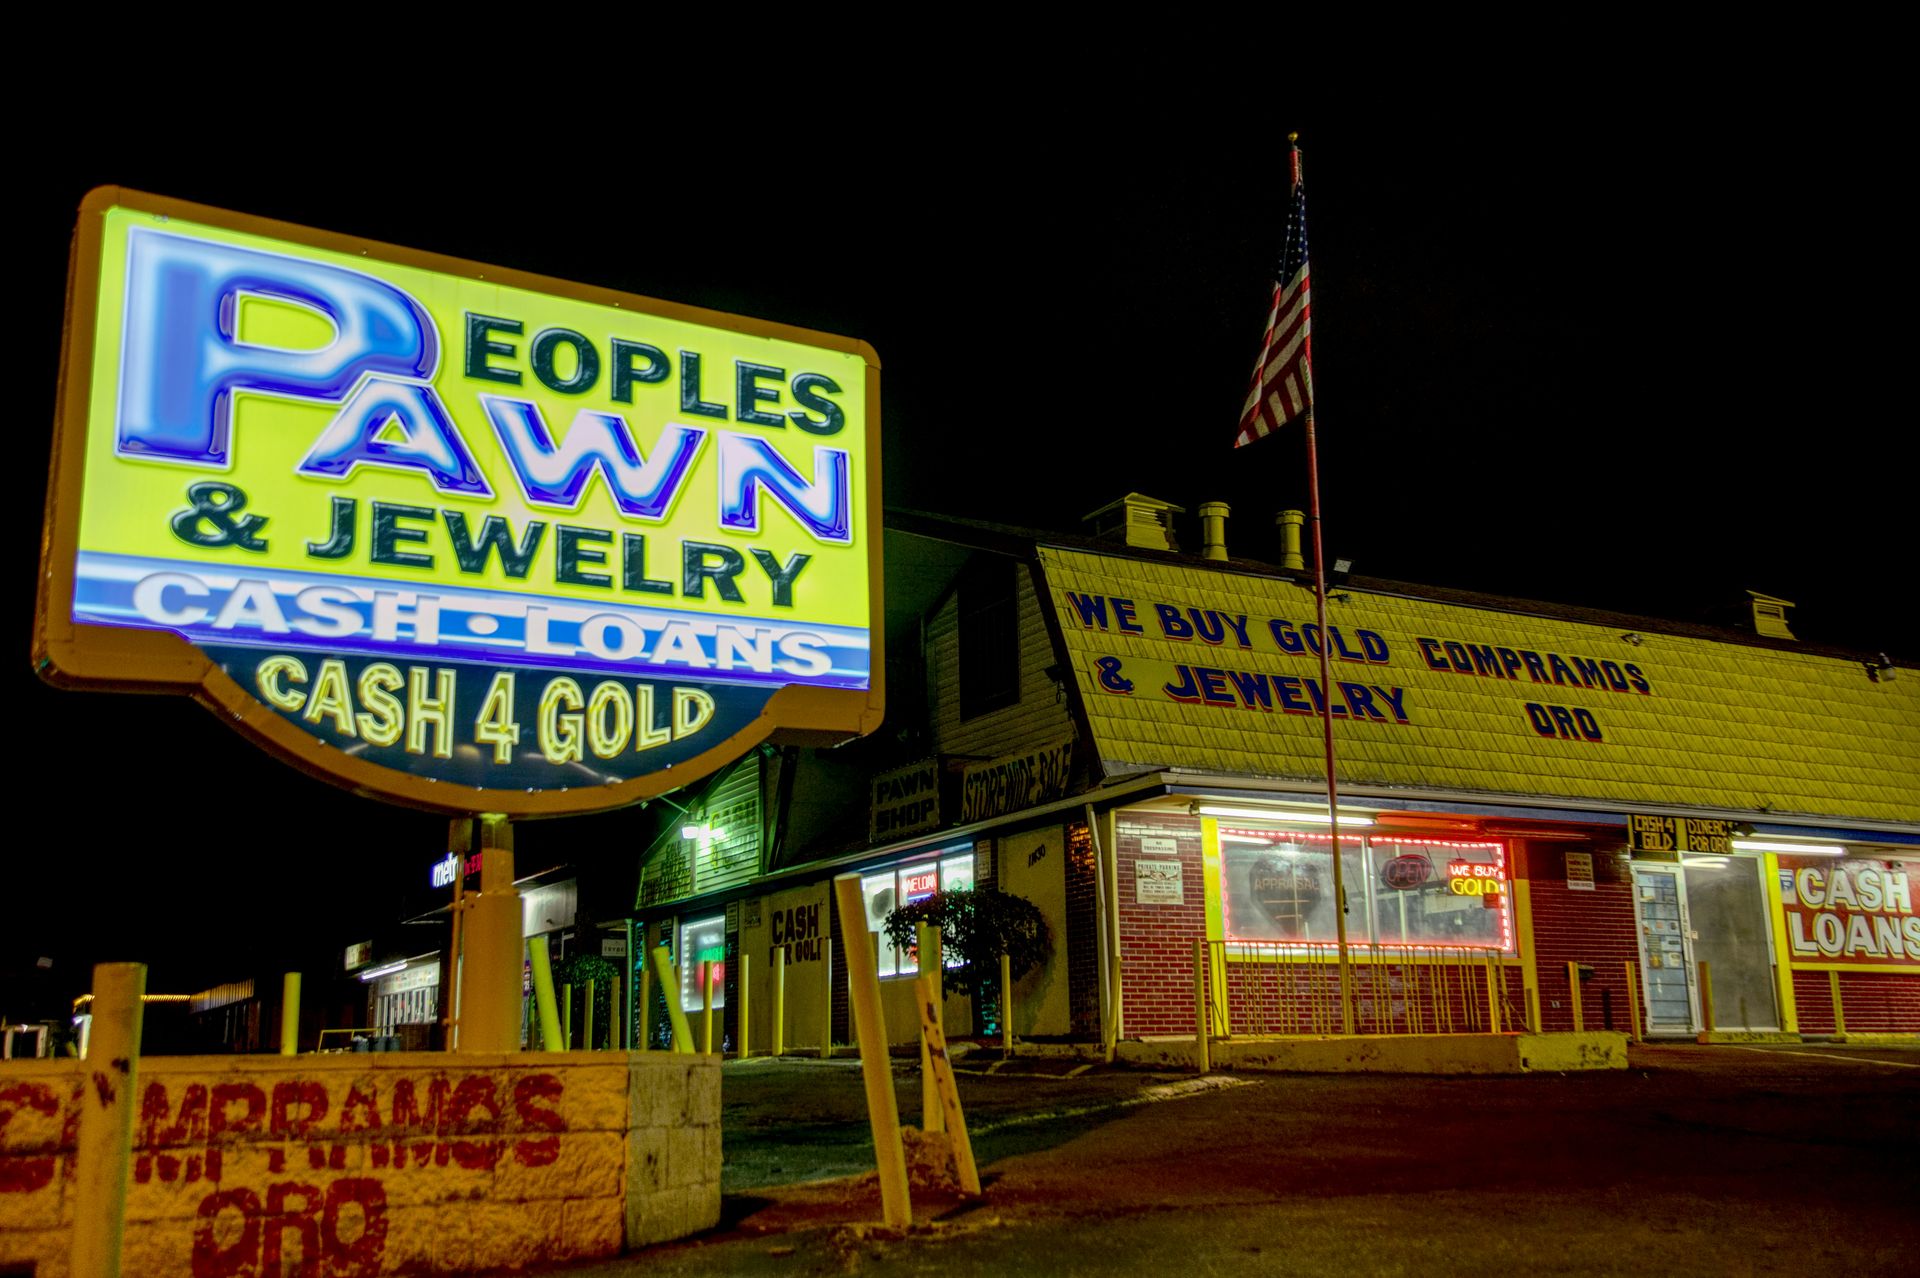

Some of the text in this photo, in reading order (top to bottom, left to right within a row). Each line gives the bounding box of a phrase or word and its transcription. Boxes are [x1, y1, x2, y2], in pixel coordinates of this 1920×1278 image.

[170, 481, 812, 608] & JEWELRY
[133, 571, 834, 679] CASH LOANS
[1066, 591, 1390, 666] WE BUY GOLD
[1416, 636, 1652, 696] COMPRAMOS
[255, 655, 716, 765] CASH 4 GOLD
[1095, 655, 1411, 726] & JEWELRY
[1524, 701, 1604, 743] ORO
[877, 768, 933, 804] PAWN
[877, 799, 934, 832] SHOP
[1633, 814, 1675, 833] CASH 4
[1642, 832, 1673, 850] GOLD
[432, 852, 459, 889] metr
[1254, 876, 1320, 891] APPRASAL
[1387, 861, 1428, 883] OPEN
[1449, 864, 1499, 877] WE BUY
[1450, 878, 1499, 896] GOLD
[1797, 866, 1913, 914] CASH
[772, 903, 819, 944] CASH
[769, 943, 792, 968] FR
[191, 1178, 388, 1278] ORO
